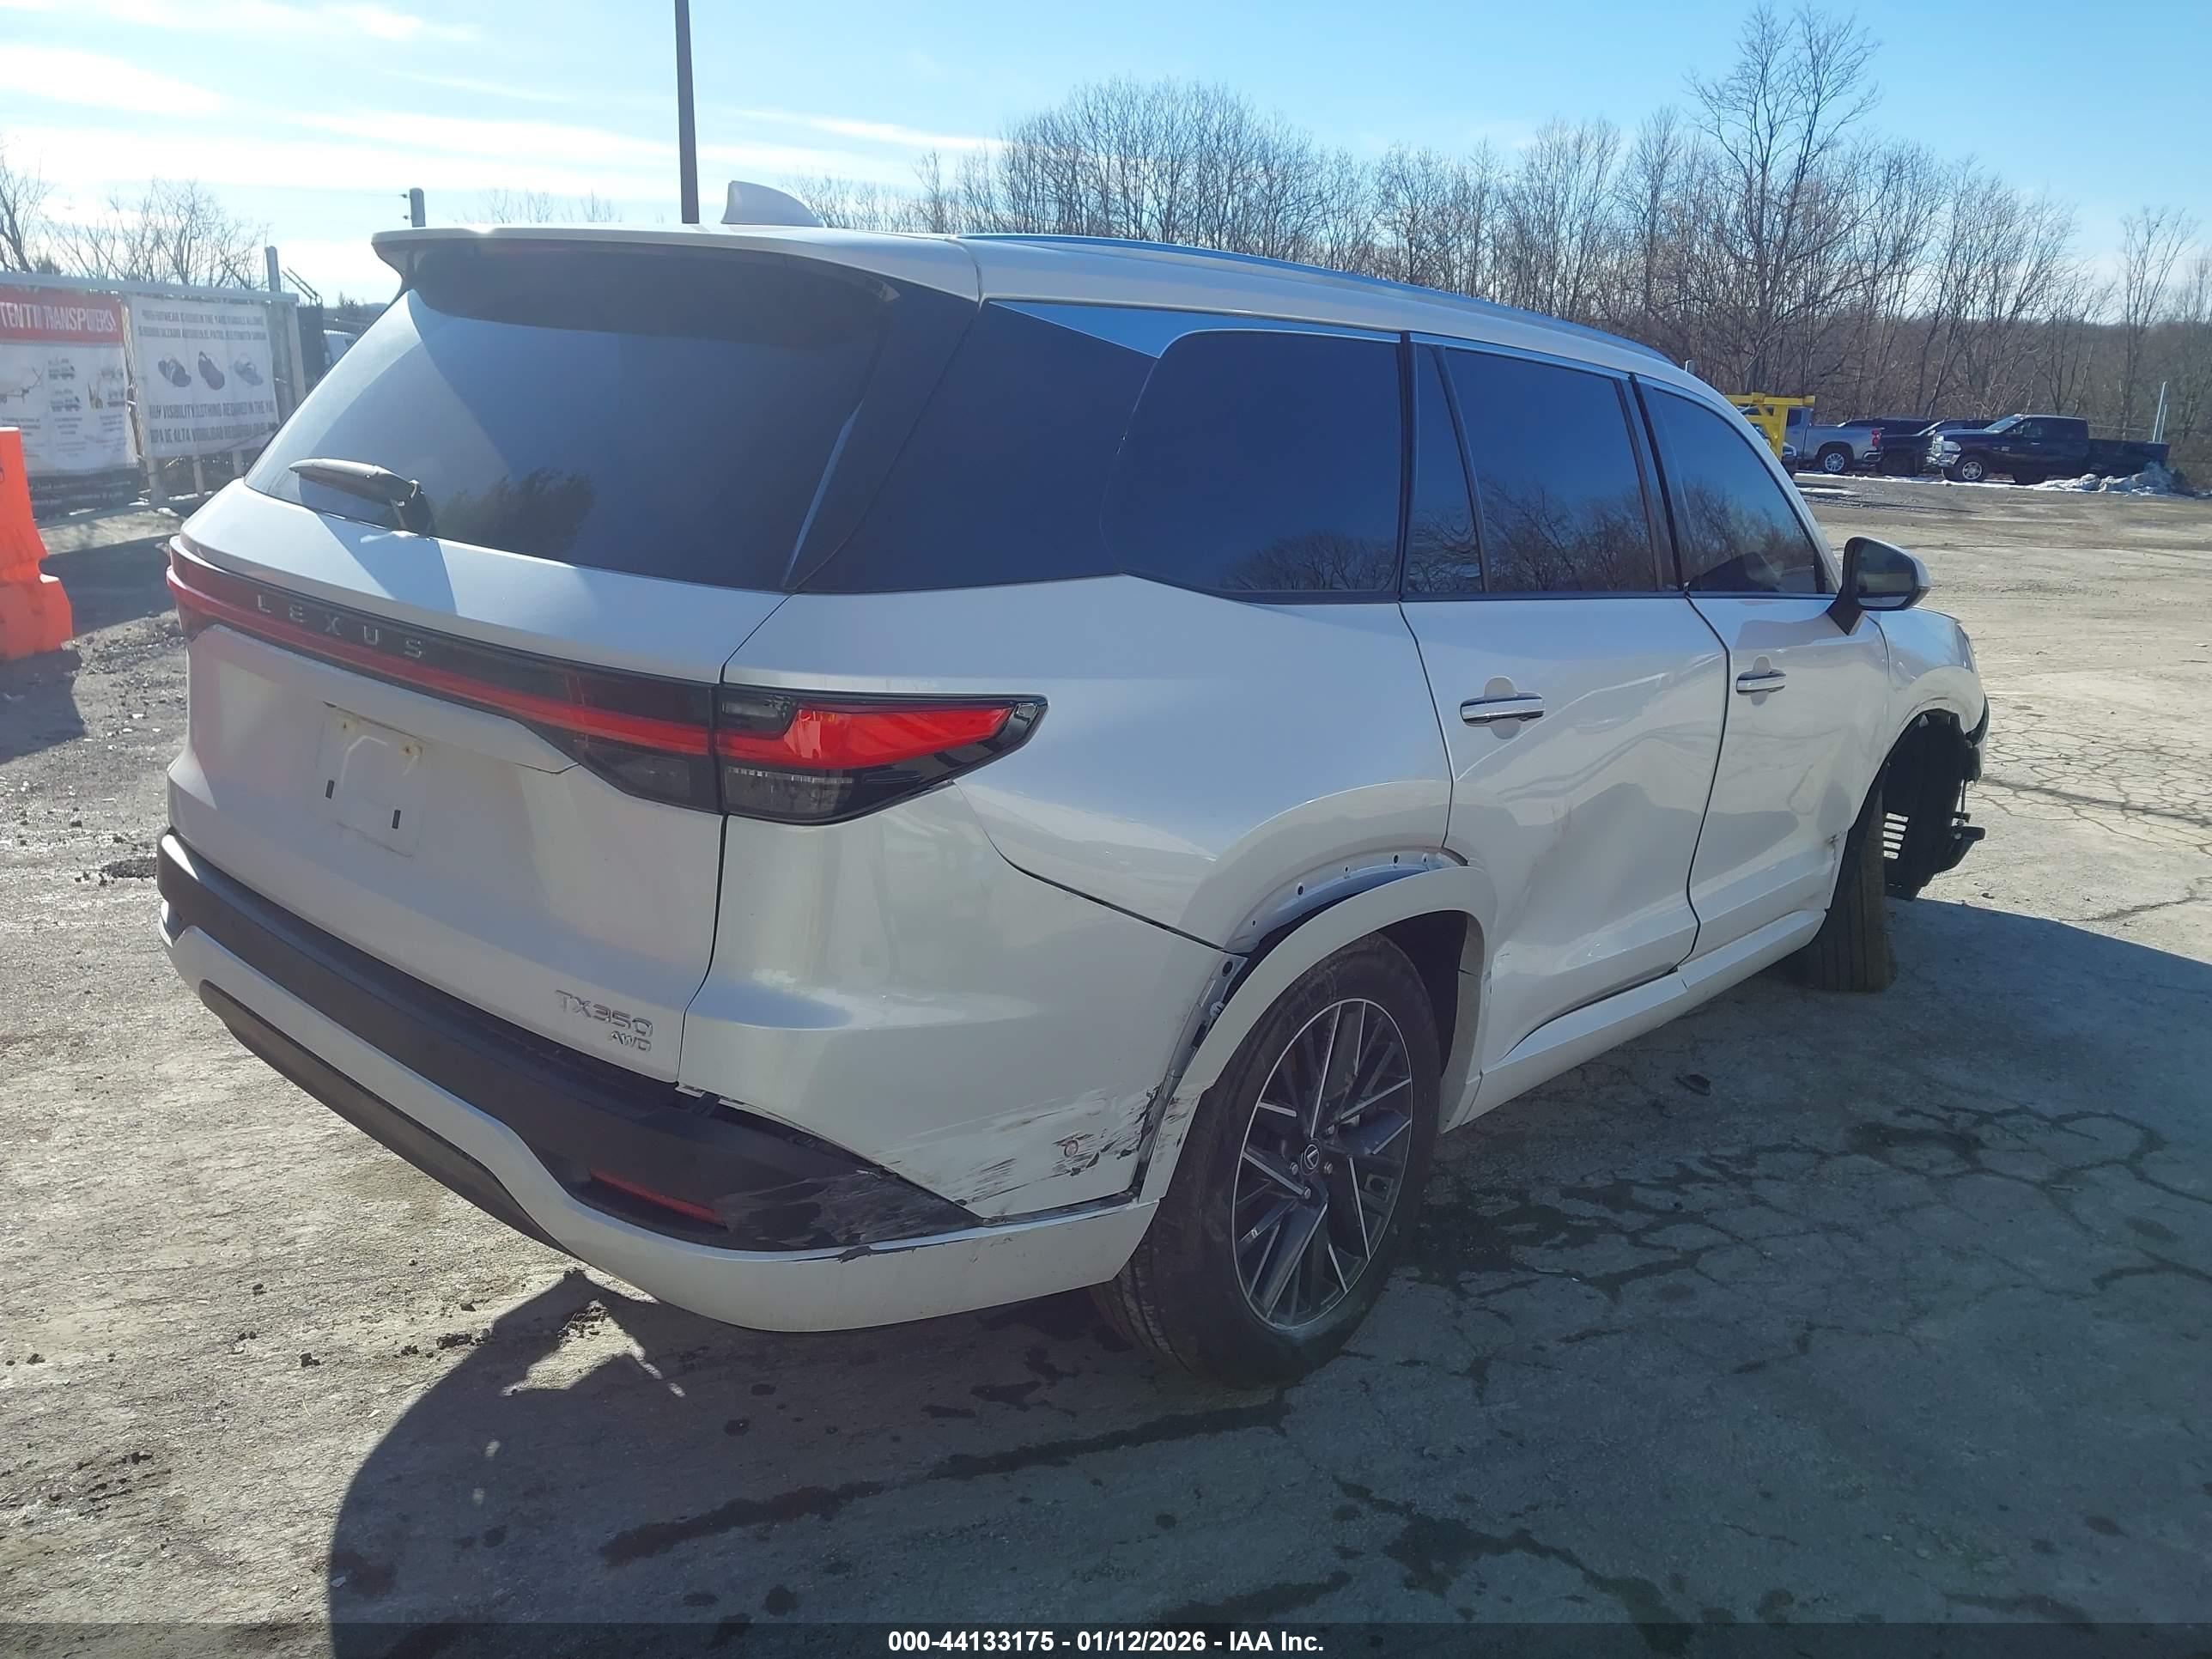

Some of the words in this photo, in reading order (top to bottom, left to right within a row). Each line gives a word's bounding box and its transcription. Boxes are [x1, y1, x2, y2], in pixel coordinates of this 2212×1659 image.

[173, 427, 190, 443] ALTA
[257, 592, 425, 659] LEXUS
[555, 989, 653, 1037] TX350
[610, 1030, 653, 1053] AWD
